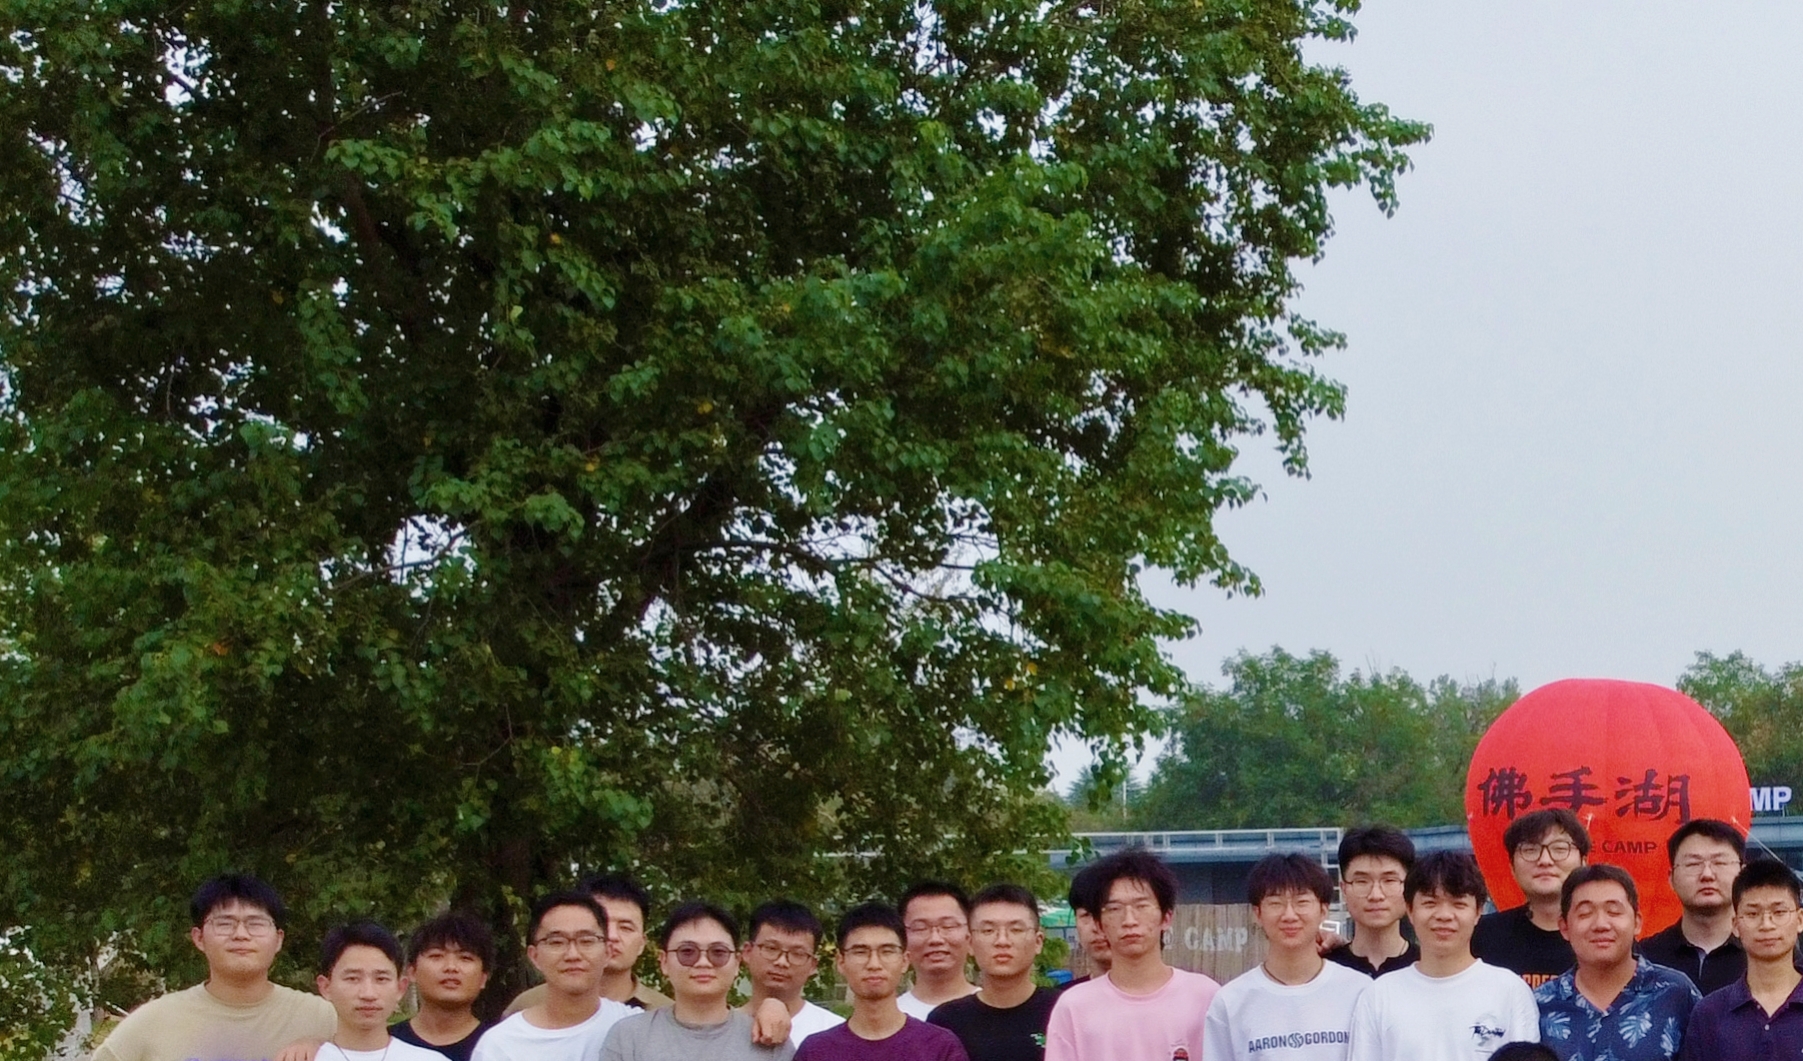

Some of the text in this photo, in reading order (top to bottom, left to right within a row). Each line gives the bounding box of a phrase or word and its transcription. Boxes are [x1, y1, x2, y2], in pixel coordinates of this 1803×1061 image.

[1477, 766, 1691, 825] 佛手湖
[1601, 841, 1658, 854] CAMP
[1184, 926, 1248, 953] CAMP
[1248, 1031, 1350, 1053] AARON GORDON
